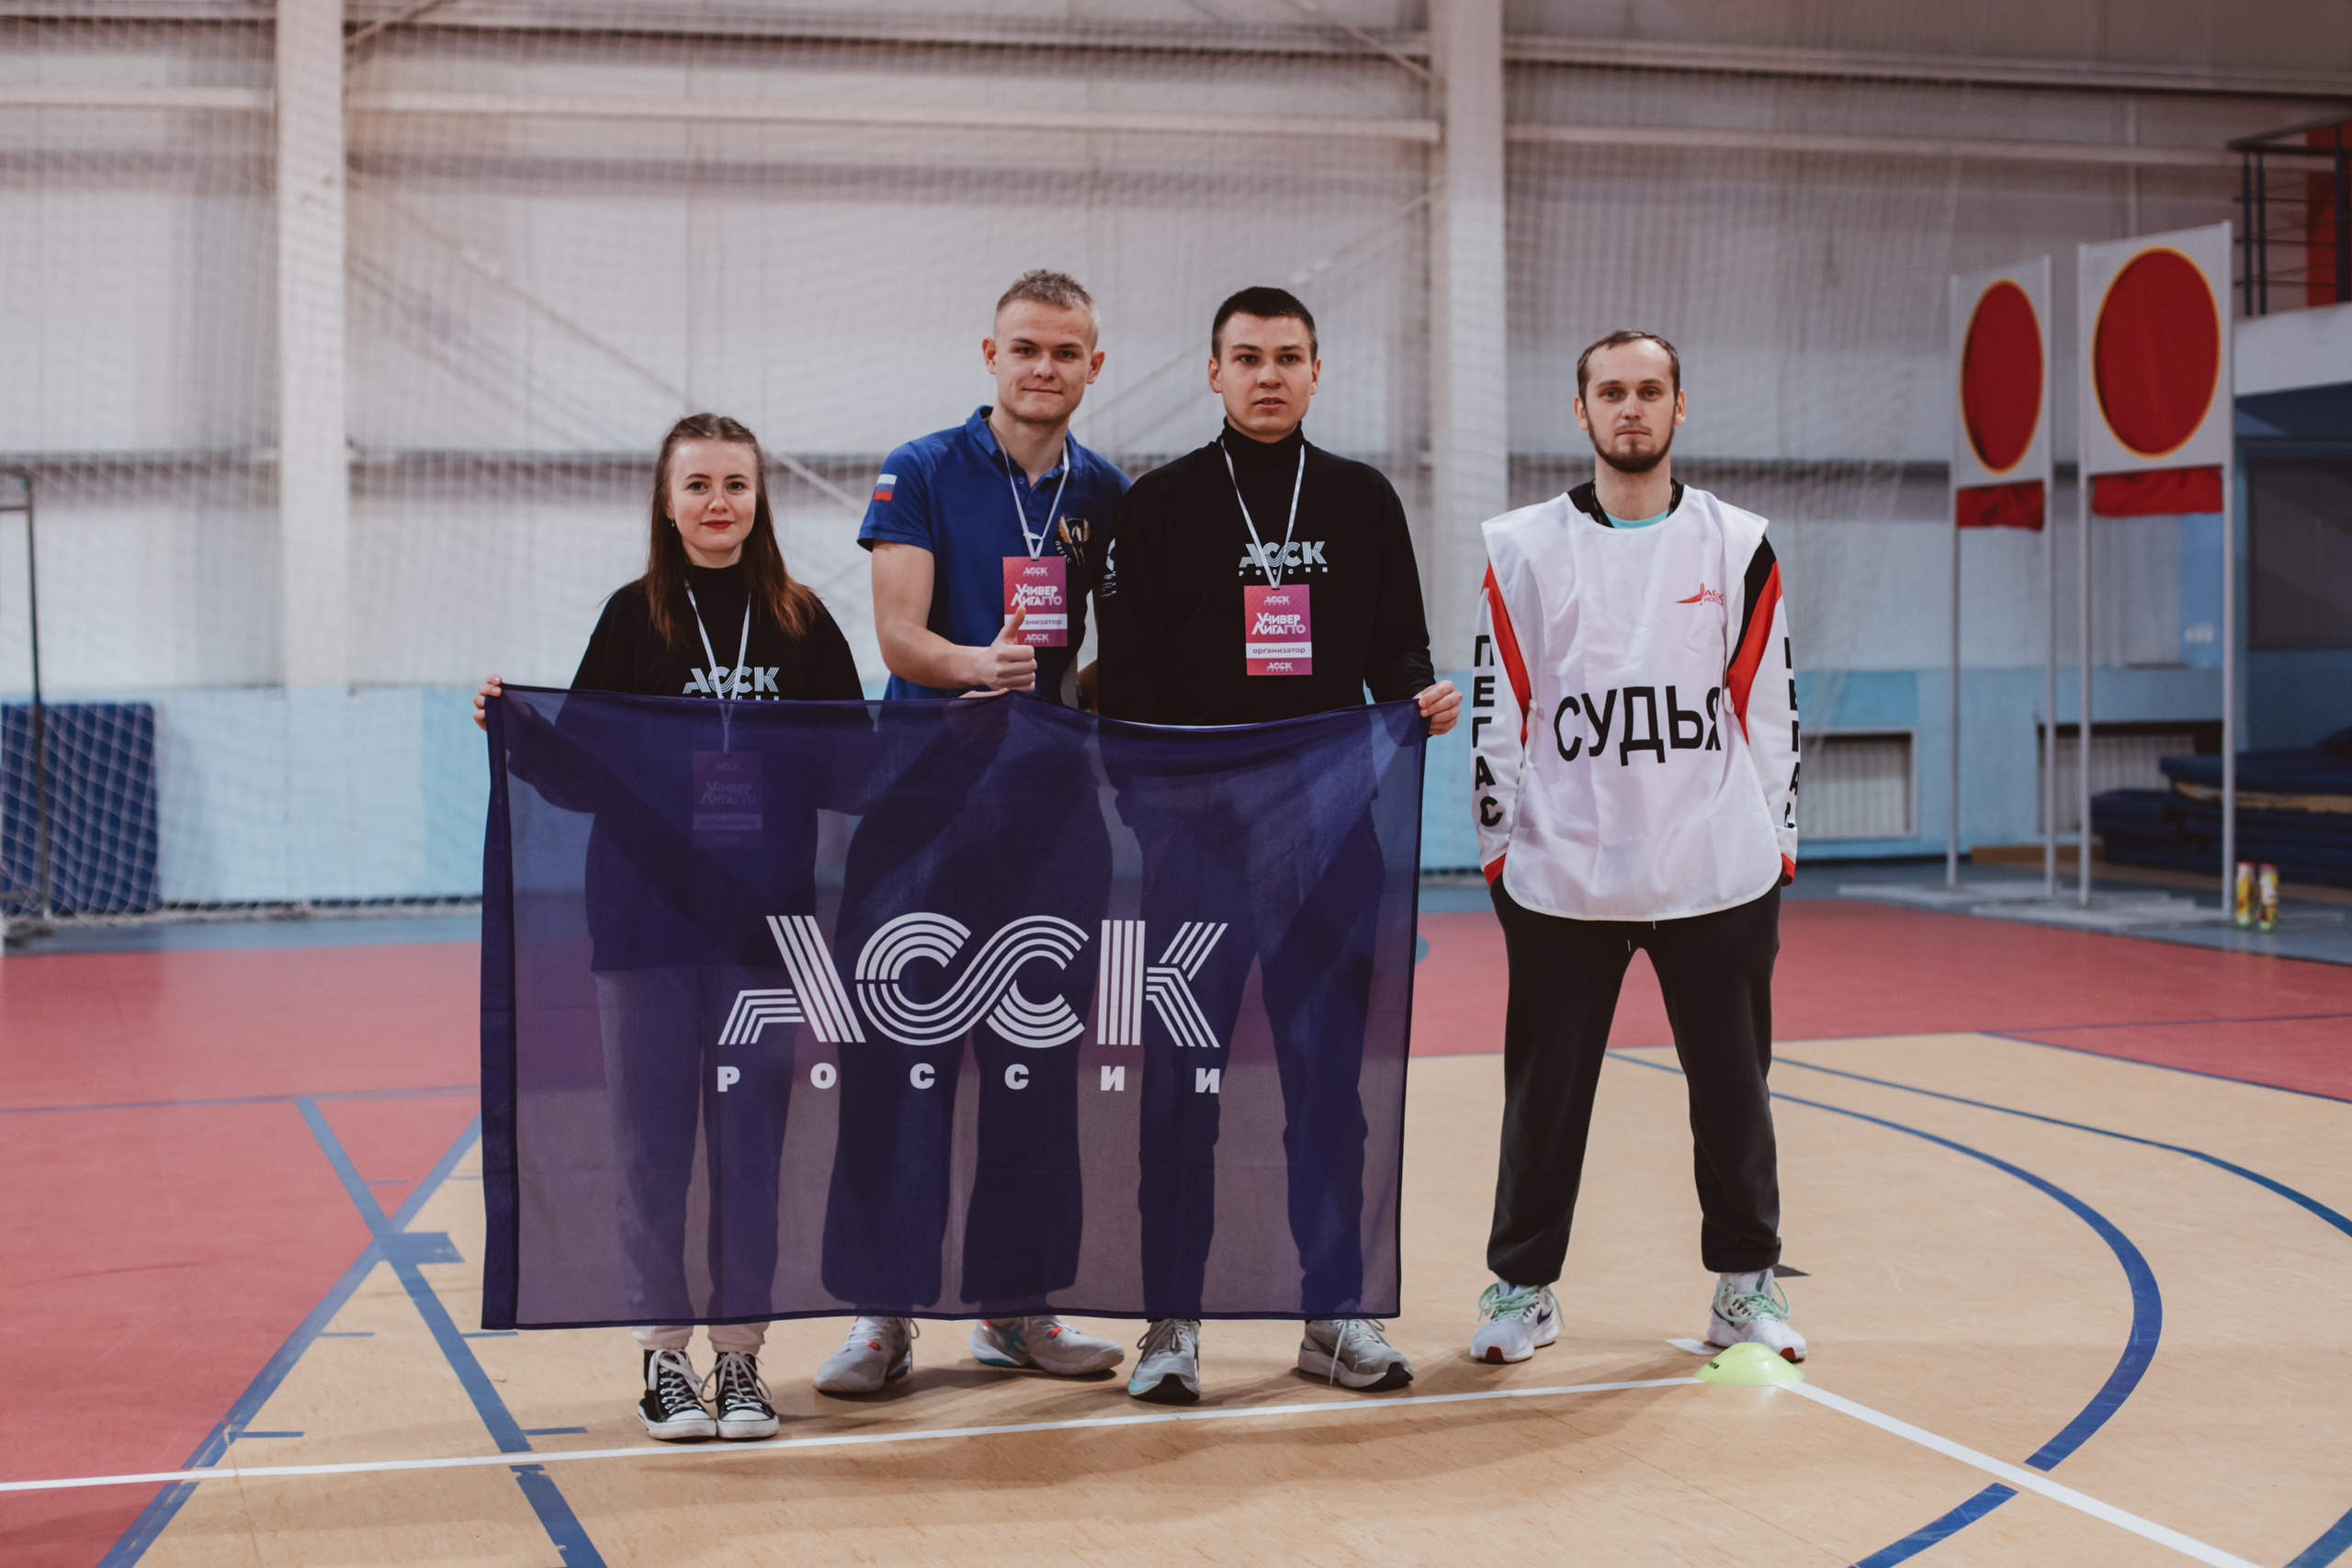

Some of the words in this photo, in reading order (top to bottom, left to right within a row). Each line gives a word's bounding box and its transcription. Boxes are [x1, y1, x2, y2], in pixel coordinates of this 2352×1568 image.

[1238, 541, 1328, 568] АССК
[1238, 567, 1329, 577] РОССИИ
[682, 666, 779, 694] АССК
[1472, 635, 1503, 827] ПЕГАС
[1554, 685, 1722, 766] СУДЬЯ
[718, 912, 1228, 1048] АССК
[717, 1063, 1221, 1093] РОССИИ
